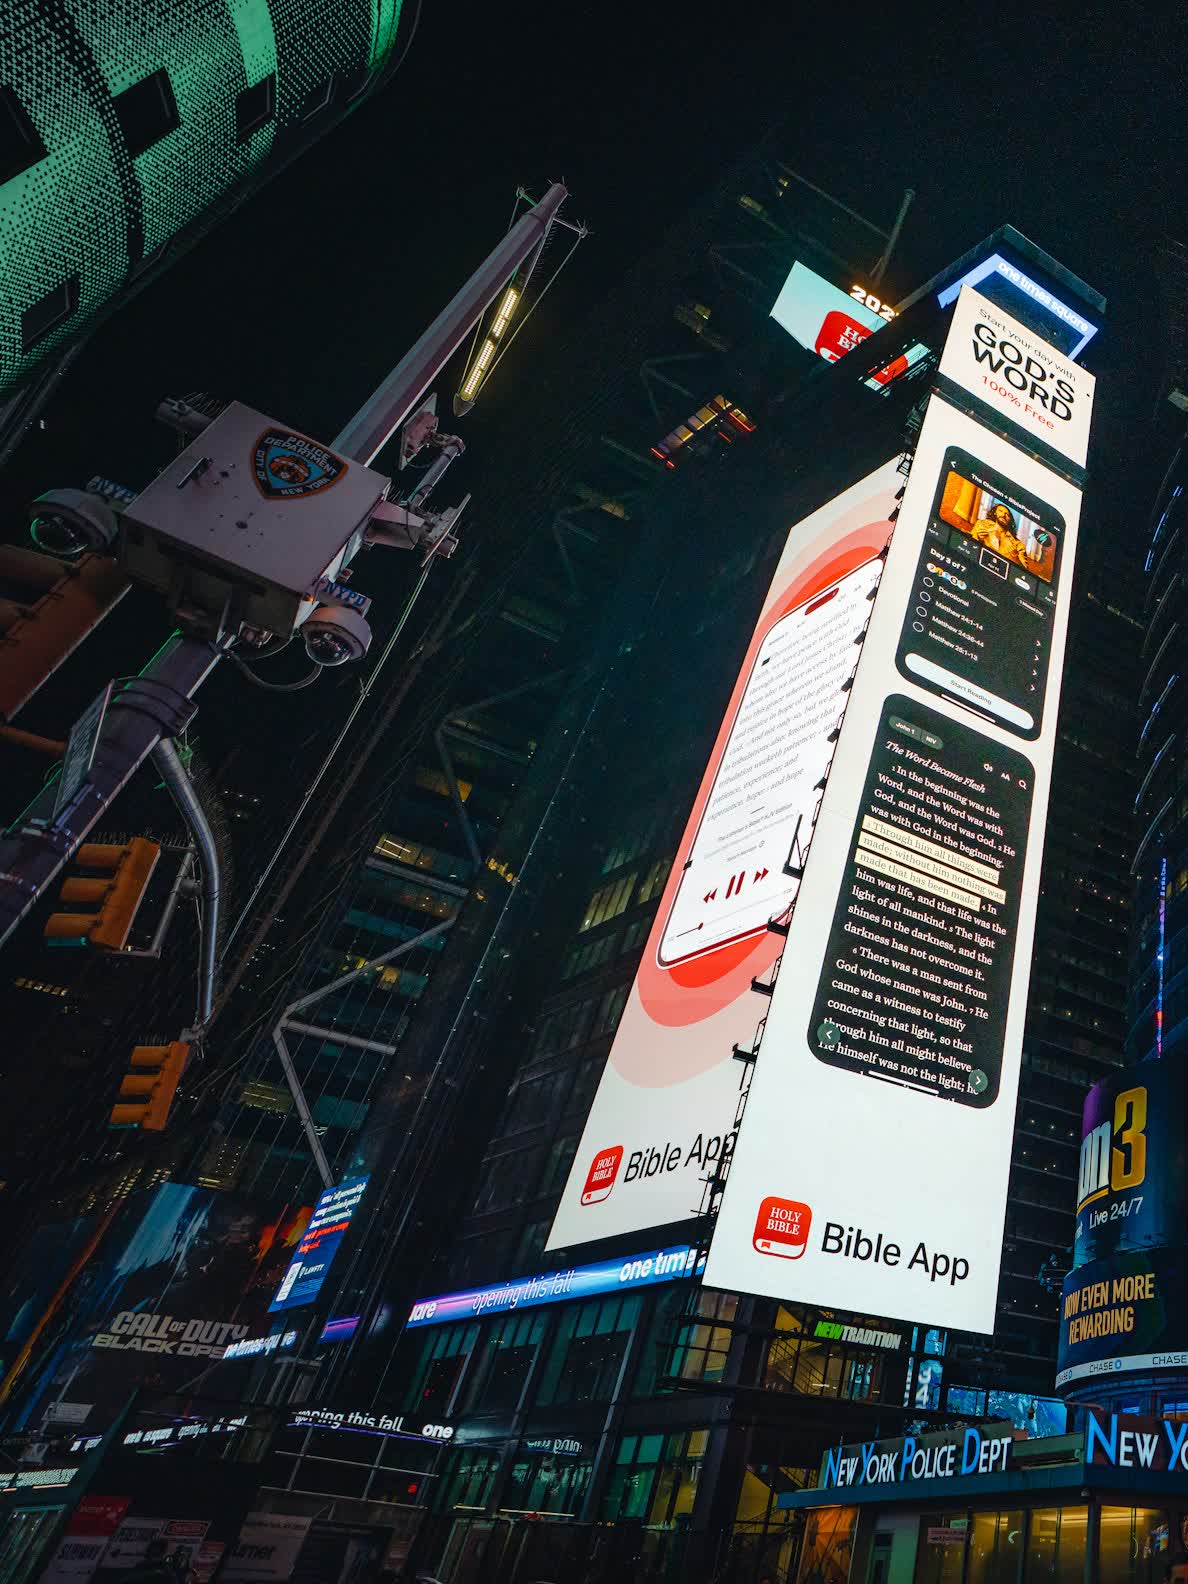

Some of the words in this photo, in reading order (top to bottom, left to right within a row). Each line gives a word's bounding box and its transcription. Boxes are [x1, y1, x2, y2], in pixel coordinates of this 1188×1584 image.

[999, 262, 1021, 281] one
[1020, 276, 1051, 303] times
[1050, 298, 1089, 332] square
[979, 308, 1007, 333] Start
[1007, 329, 1033, 350] your
[1034, 346, 1053, 365] day
[1055, 362, 1077, 381] with
[974, 323, 1075, 403] GOD'S
[972, 338, 1072, 421] WORD
[981, 375, 1020, 407] 100%
[1024, 404, 1055, 430] Free
[256, 450, 264, 467] CITY
[264, 437, 337, 476] DEPARTMENT
[289, 436, 330, 459] POLICE
[256, 470, 267, 481] OF
[280, 487, 304, 495] NEW
[307, 478, 331, 490] YORK
[971, 474, 982, 483] The
[930, 548, 946, 561] Day
[945, 556, 952, 564] 3
[952, 559, 961, 569] of
[938, 586, 970, 607] Devotional
[935, 601, 960, 618] Matthew
[932, 616, 957, 634] Matthew
[928, 631, 955, 650] Matthew
[950, 680, 967, 693] Start
[967, 688, 992, 705] Reading
[895, 722, 911, 734] John
[926, 735, 937, 744] NIV
[886, 740, 904, 755] The
[905, 749, 931, 767] Word
[929, 759, 964, 782] Became
[962, 776, 986, 793] Flesh
[896, 765, 907, 777] In
[908, 771, 924, 784] the
[924, 777, 969, 806] beginning
[968, 799, 985, 813] was
[985, 806, 1000, 819] the
[870, 805, 889, 819] was
[890, 813, 911, 829] with
[912, 822, 932, 837] God
[932, 830, 942, 842] in
[943, 835, 959, 849] the
[959, 841, 1005, 869] beginning.
[831, 980, 860, 996] came
[861, 990, 874, 1000] as
[883, 996, 922, 1016] witness
[922, 1009, 934, 1020] to
[935, 1013, 967, 1033] testify
[596, 1155, 617, 1170] HOLY
[624, 1143, 682, 1183] Bible
[592, 1167, 614, 1182] BIBLE
[770, 1207, 802, 1223] HOLY
[1089, 1209, 1108, 1229] Live
[1110, 1196, 1144, 1221] 24/7
[767, 1219, 800, 1235] BIBLE
[821, 1221, 901, 1266] Bible
[907, 1242, 970, 1286] App
[620, 1258, 654, 1282] one
[472, 1283, 521, 1315] opening
[523, 1275, 548, 1300] this
[549, 1270, 575, 1295] fall
[1064, 1289, 1081, 1320] NOW
[1081, 1280, 1109, 1311] EVEN
[1113, 1273, 1155, 1303] MORE
[110, 1311, 174, 1338] CALL
[169, 1321, 188, 1332] OF
[181, 1319, 249, 1345] DUTY
[1069, 1306, 1135, 1345] REWARDING
[92, 1334, 182, 1354] BLACK
[177, 1343, 228, 1359] OPS
[1089, 1361, 1113, 1373] CHASE
[1152, 1354, 1188, 1365] CHASE
[348, 1411, 376, 1428] this
[378, 1414, 404, 1432] fall
[422, 1422, 454, 1438] one
